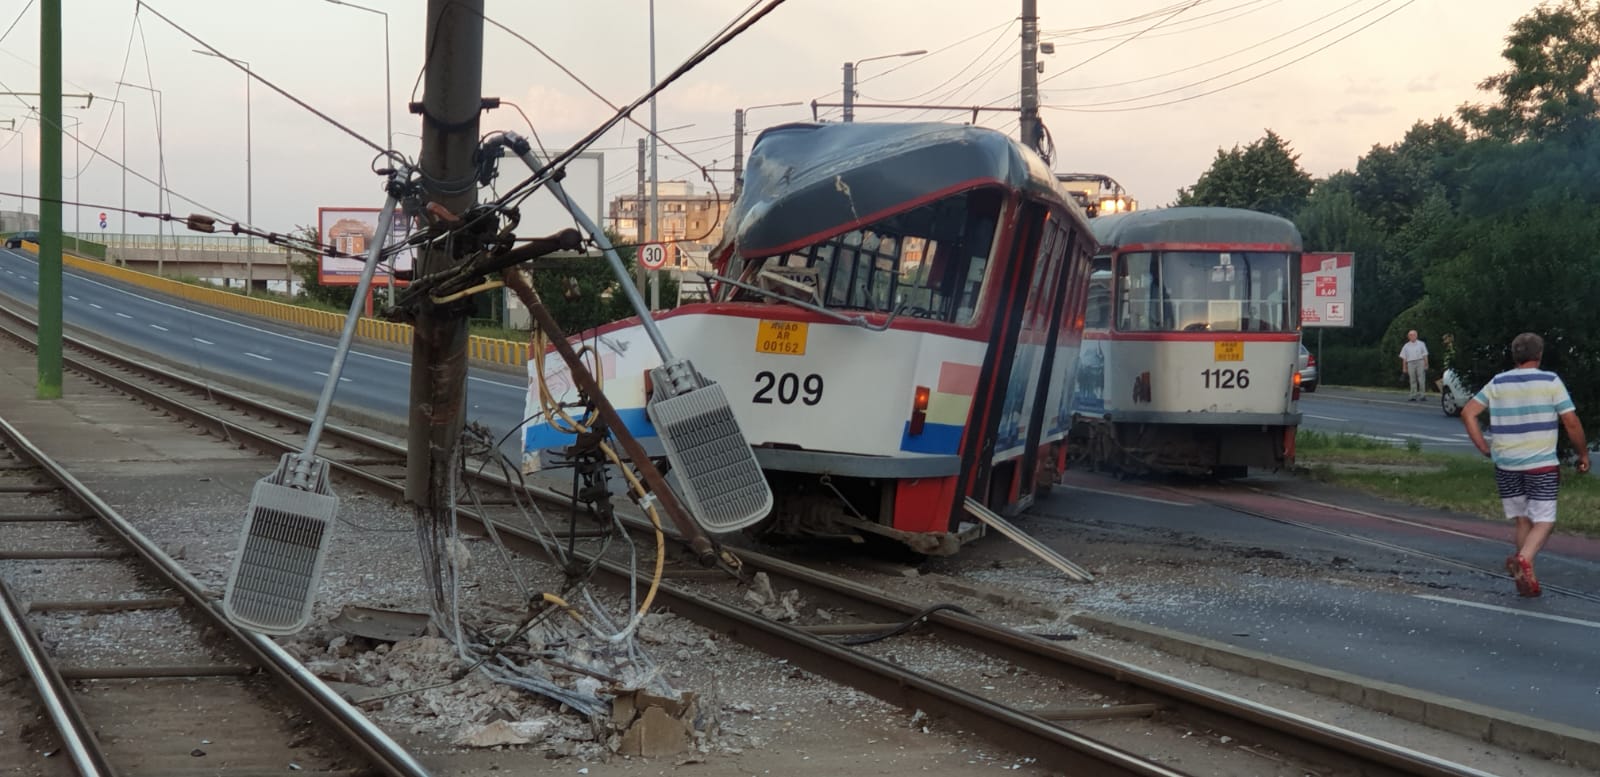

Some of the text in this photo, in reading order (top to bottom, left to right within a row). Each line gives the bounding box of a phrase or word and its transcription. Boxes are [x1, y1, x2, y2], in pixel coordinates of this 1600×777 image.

[646, 247, 662, 262] 30
[776, 331, 790, 341] AR
[763, 340, 799, 353] 00162
[1201, 368, 1250, 389] 1126
[752, 371, 824, 406] 209
